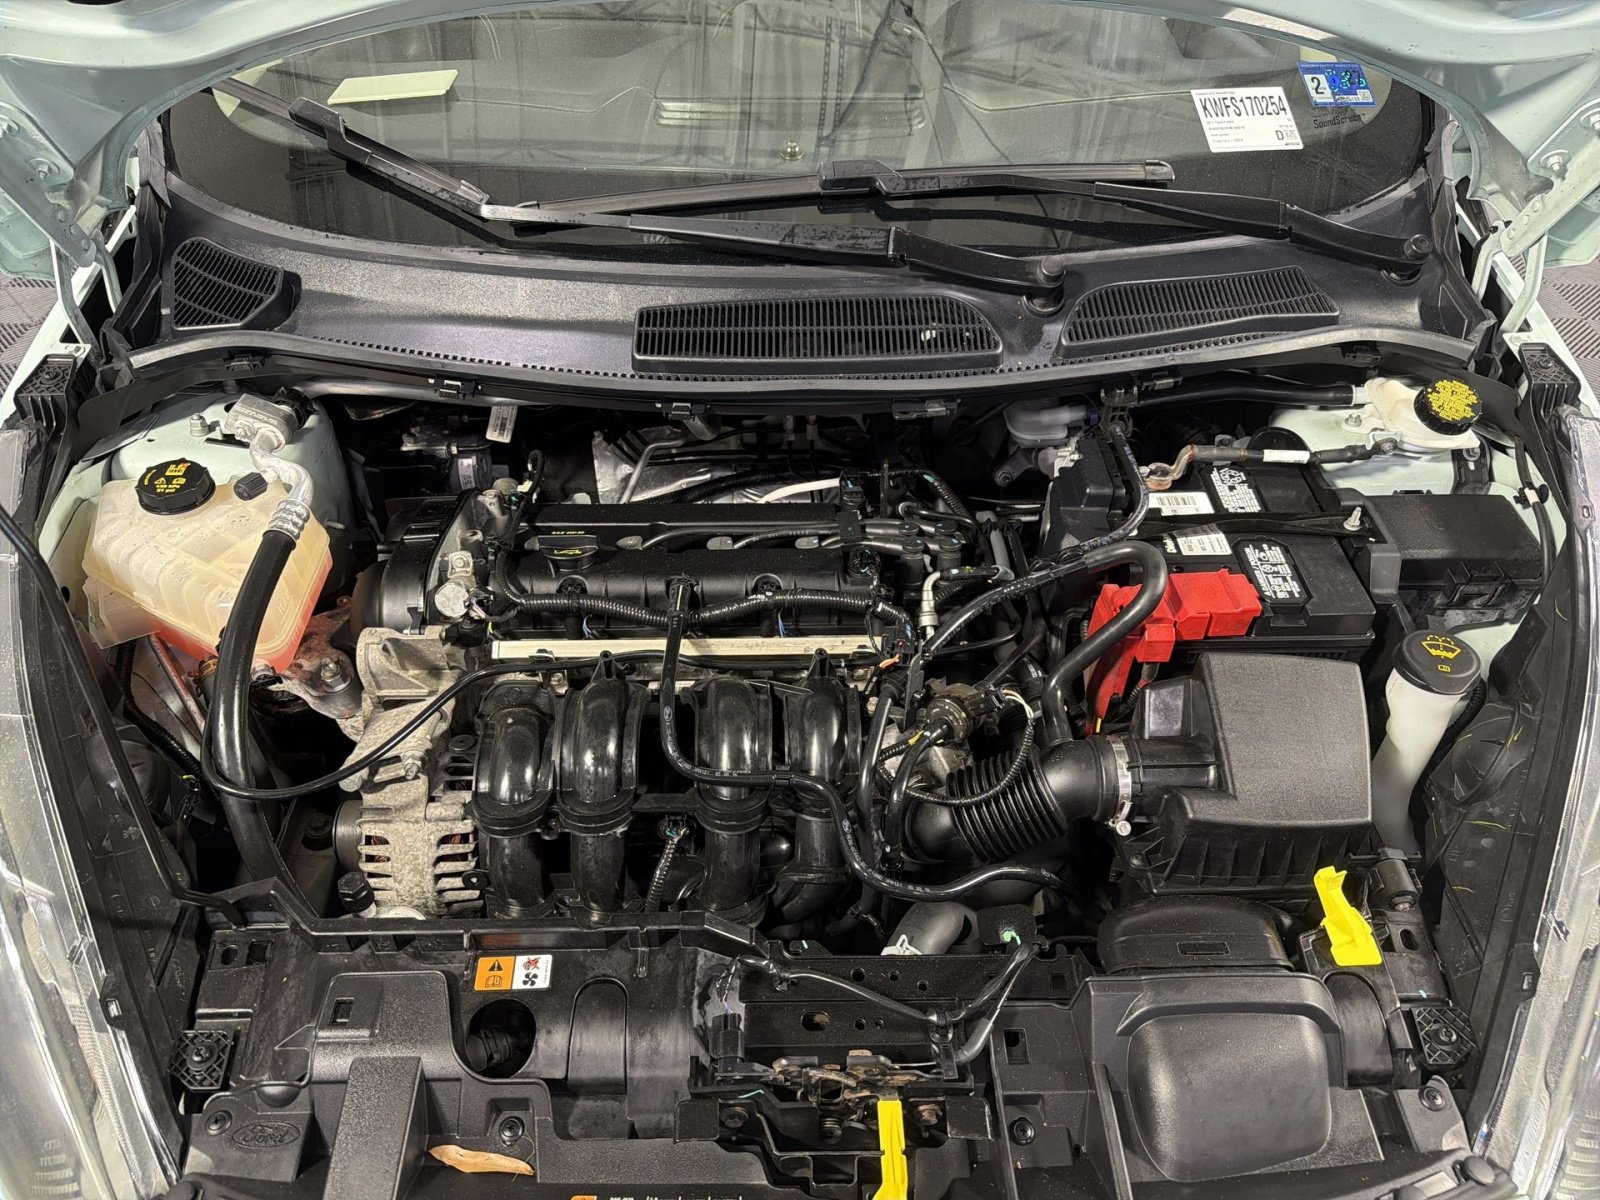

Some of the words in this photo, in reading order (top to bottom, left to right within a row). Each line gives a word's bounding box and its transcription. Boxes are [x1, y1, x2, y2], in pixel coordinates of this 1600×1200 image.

[1310, 76, 1325, 95] 2
[1199, 95, 1287, 119] KWFS170254
[1275, 130, 1285, 141] D
[238, 1123, 290, 1145] Ford
